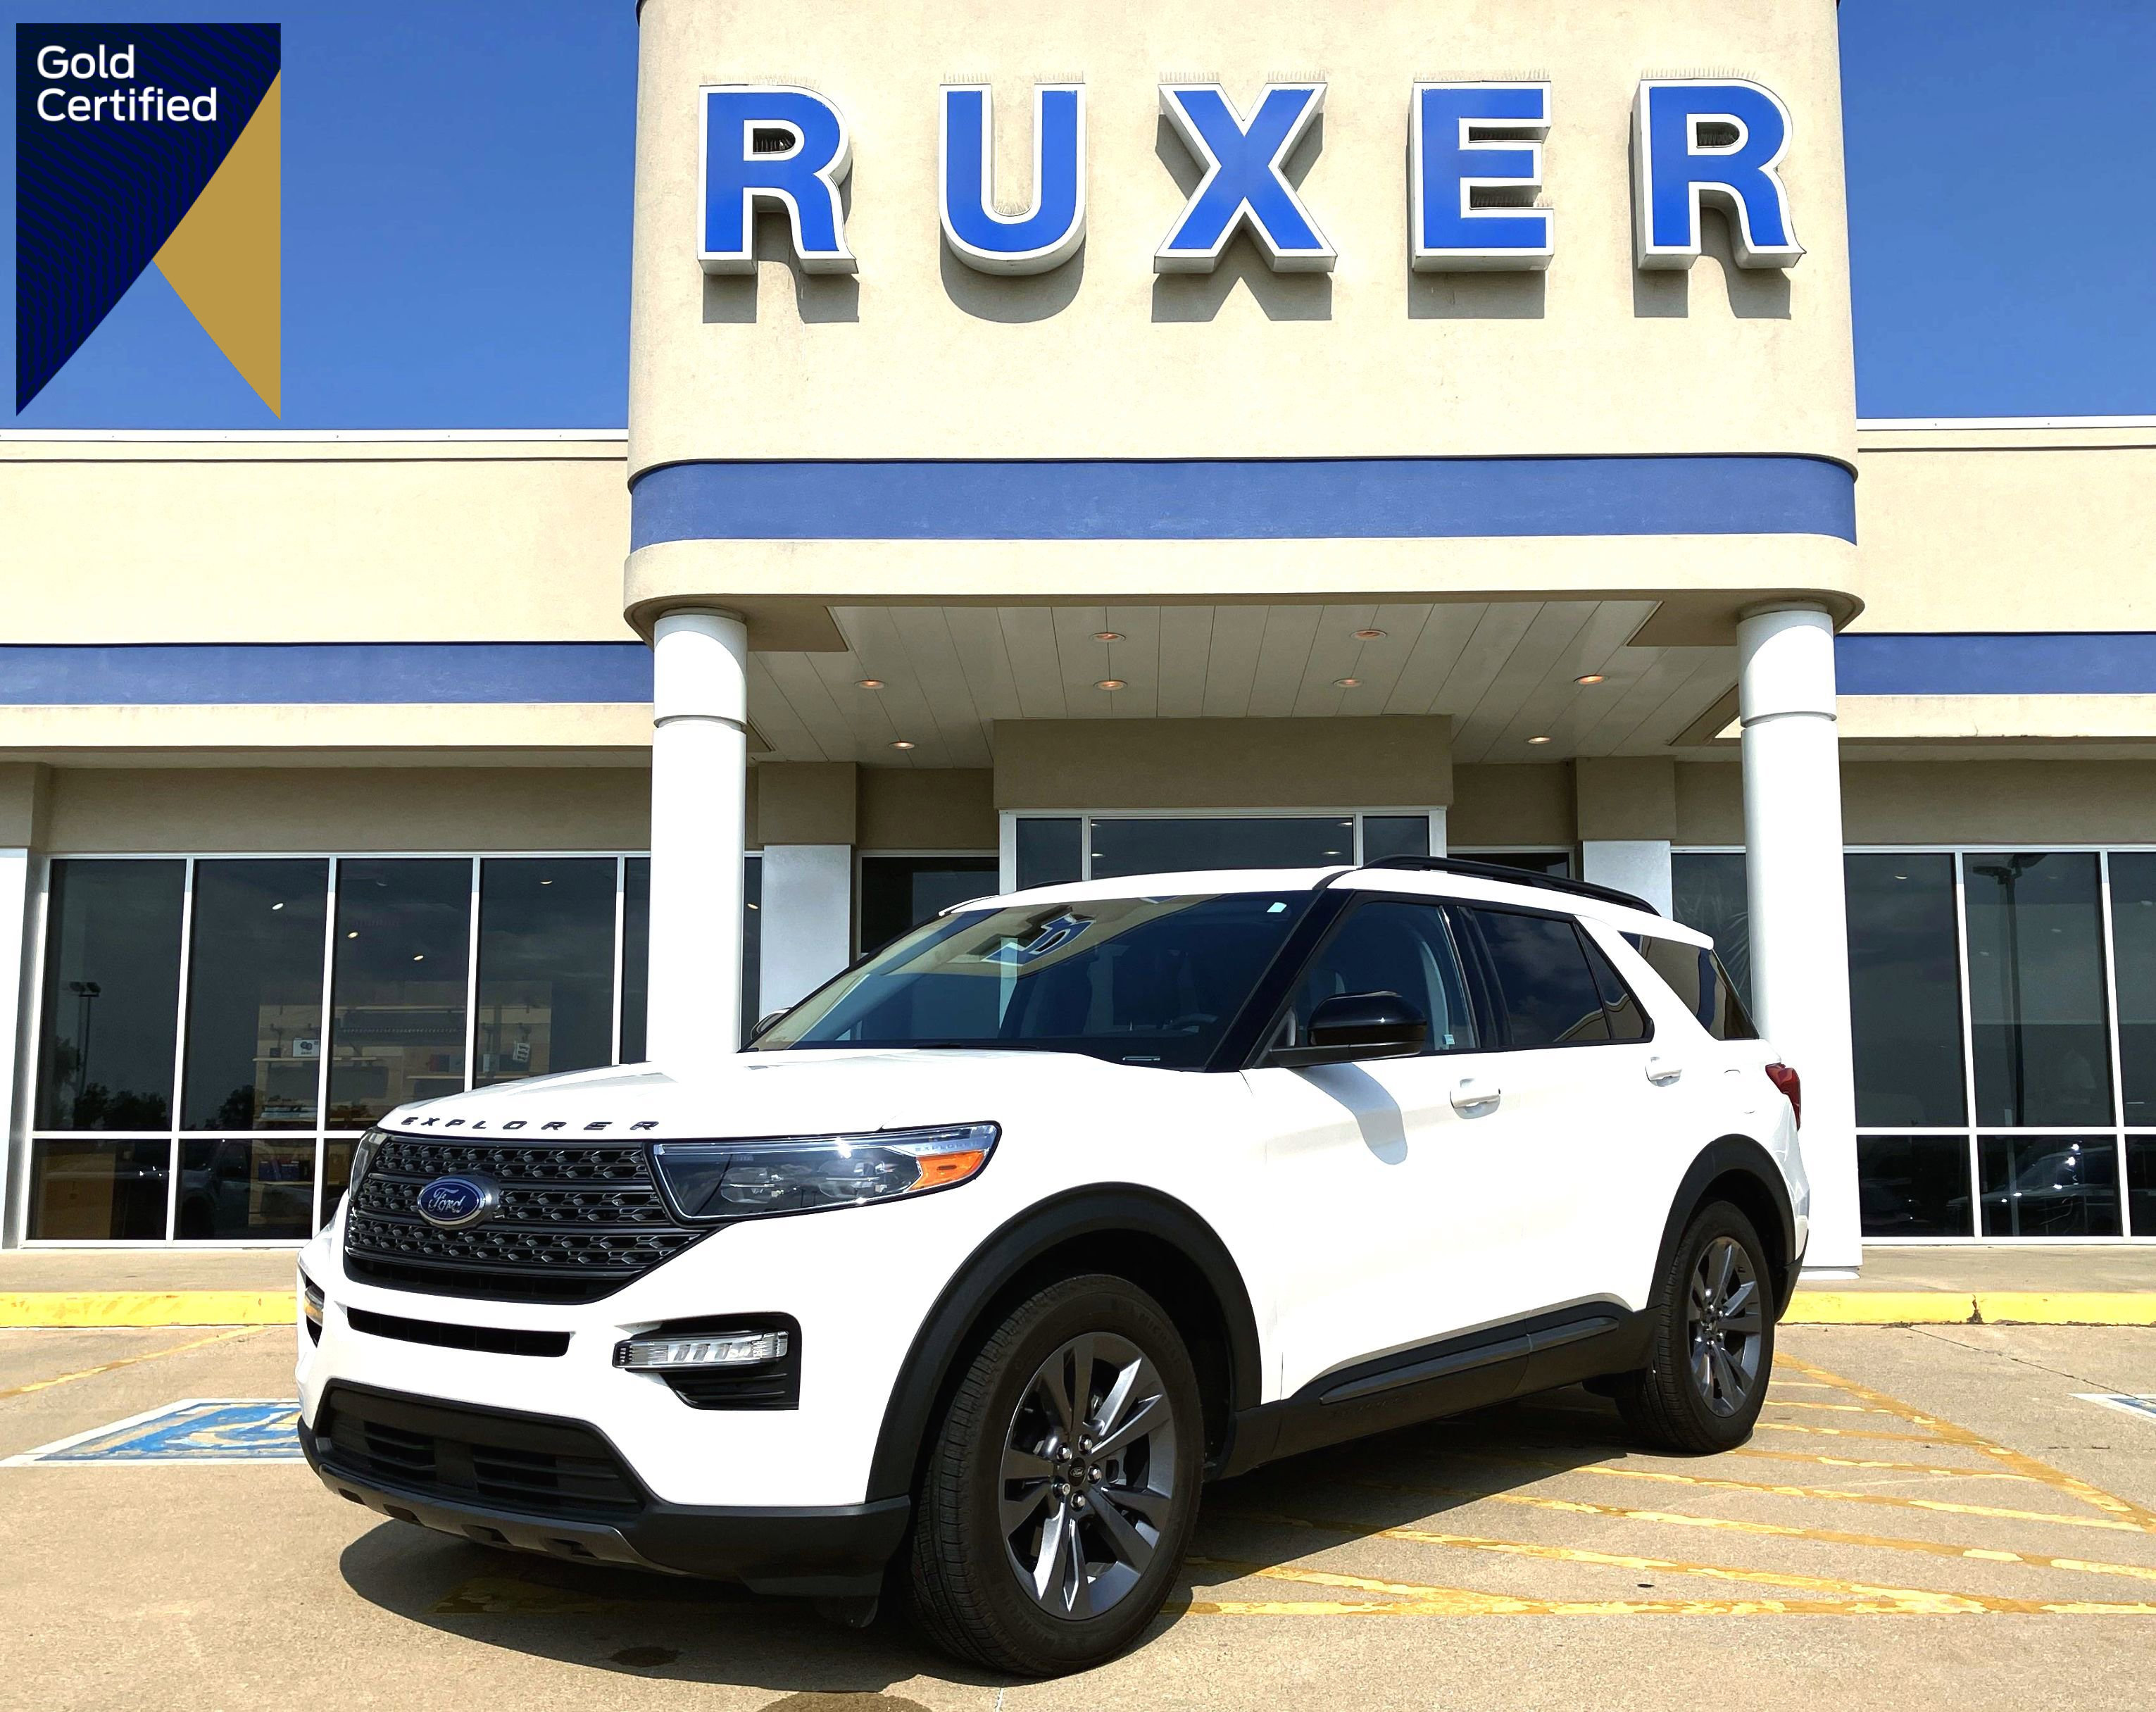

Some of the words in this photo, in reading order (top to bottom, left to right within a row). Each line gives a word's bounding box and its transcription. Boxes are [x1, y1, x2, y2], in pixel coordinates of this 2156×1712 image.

[696, 79, 1806, 275] RUXER
[401, 1116, 659, 1130] EXPLORER
[427, 1187, 466, 1213] Ford
